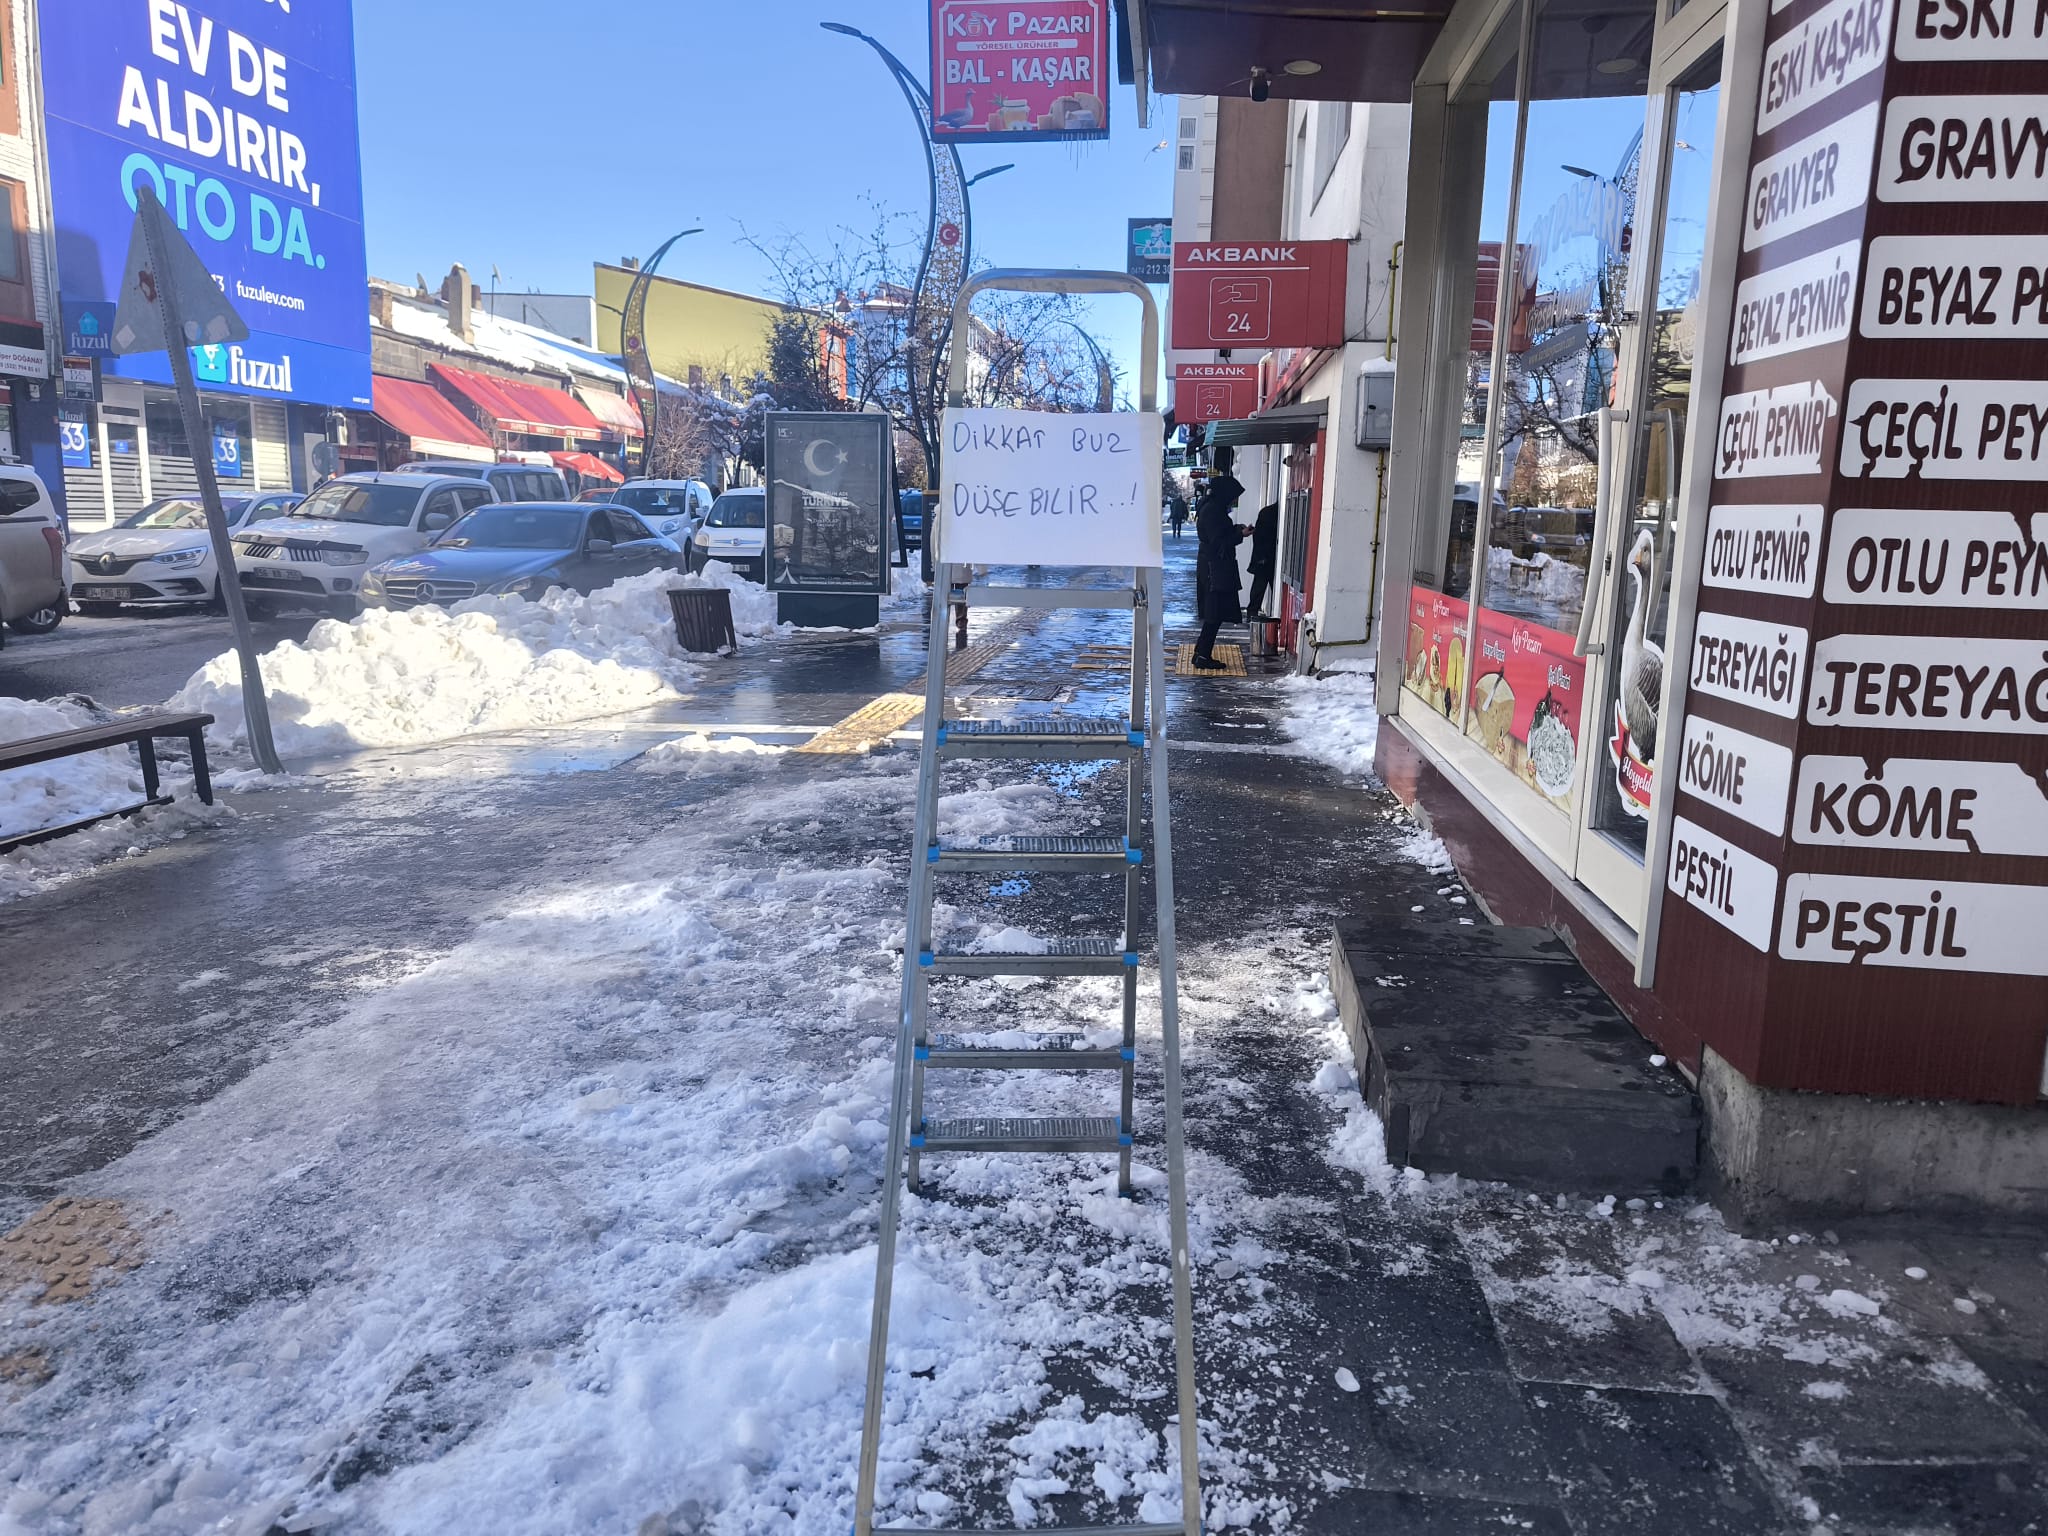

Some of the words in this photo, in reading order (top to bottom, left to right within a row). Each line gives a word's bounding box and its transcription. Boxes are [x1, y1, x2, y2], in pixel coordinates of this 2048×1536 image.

[976, 41, 1014, 50] YÖRESEL
[1016, 40, 1059, 49] ÜRÜNLER
[1008, 12, 1090, 36] PAZARI
[148, 0, 213, 76] EV
[227, 30, 289, 113] DE
[946, 59, 991, 84] BAL
[1012, 56, 1091, 88] KAŞAR
[1765, 23, 1808, 114] ESKİ
[1810, 0, 1883, 85] KAŞAR
[117, 65, 320, 206] ALDIRIR,
[121, 152, 236, 241] OTO
[250, 193, 326, 269] DA.
[1752, 142, 1840, 231] GRAVYER
[1146, 264, 1160, 275] 212
[1187, 247, 1297, 263] AKBANK
[236, 280, 305, 311] fuzulev.com
[1227, 313, 1251, 333] 24
[1736, 291, 1785, 353] BEYAZ
[1785, 256, 1850, 341] PEYNİR
[1878, 266, 2002, 325] BEYAZ
[71, 332, 109, 350] fuzul
[228, 345, 293, 392] fuzul
[1184, 367, 1245, 375] AKBANK
[1206, 404, 1221, 415] 24
[1722, 395, 1760, 474] ÇEÇİL
[1763, 386, 1827, 458] PEYNİR
[1852, 385, 1963, 476] ÇEÇİL
[217, 437, 237, 462] 33
[1711, 528, 1749, 580] OTLU
[1751, 514, 1810, 584] PEYNİR
[1847, 536, 1949, 595] OTLU
[1694, 632, 1797, 704] TEREYAĞI
[1684, 731, 1746, 805] KÖME
[1809, 766, 1978, 841] KÖME
[1674, 839, 1735, 917] PESTİL
[1795, 889, 1968, 960] PESTİL
